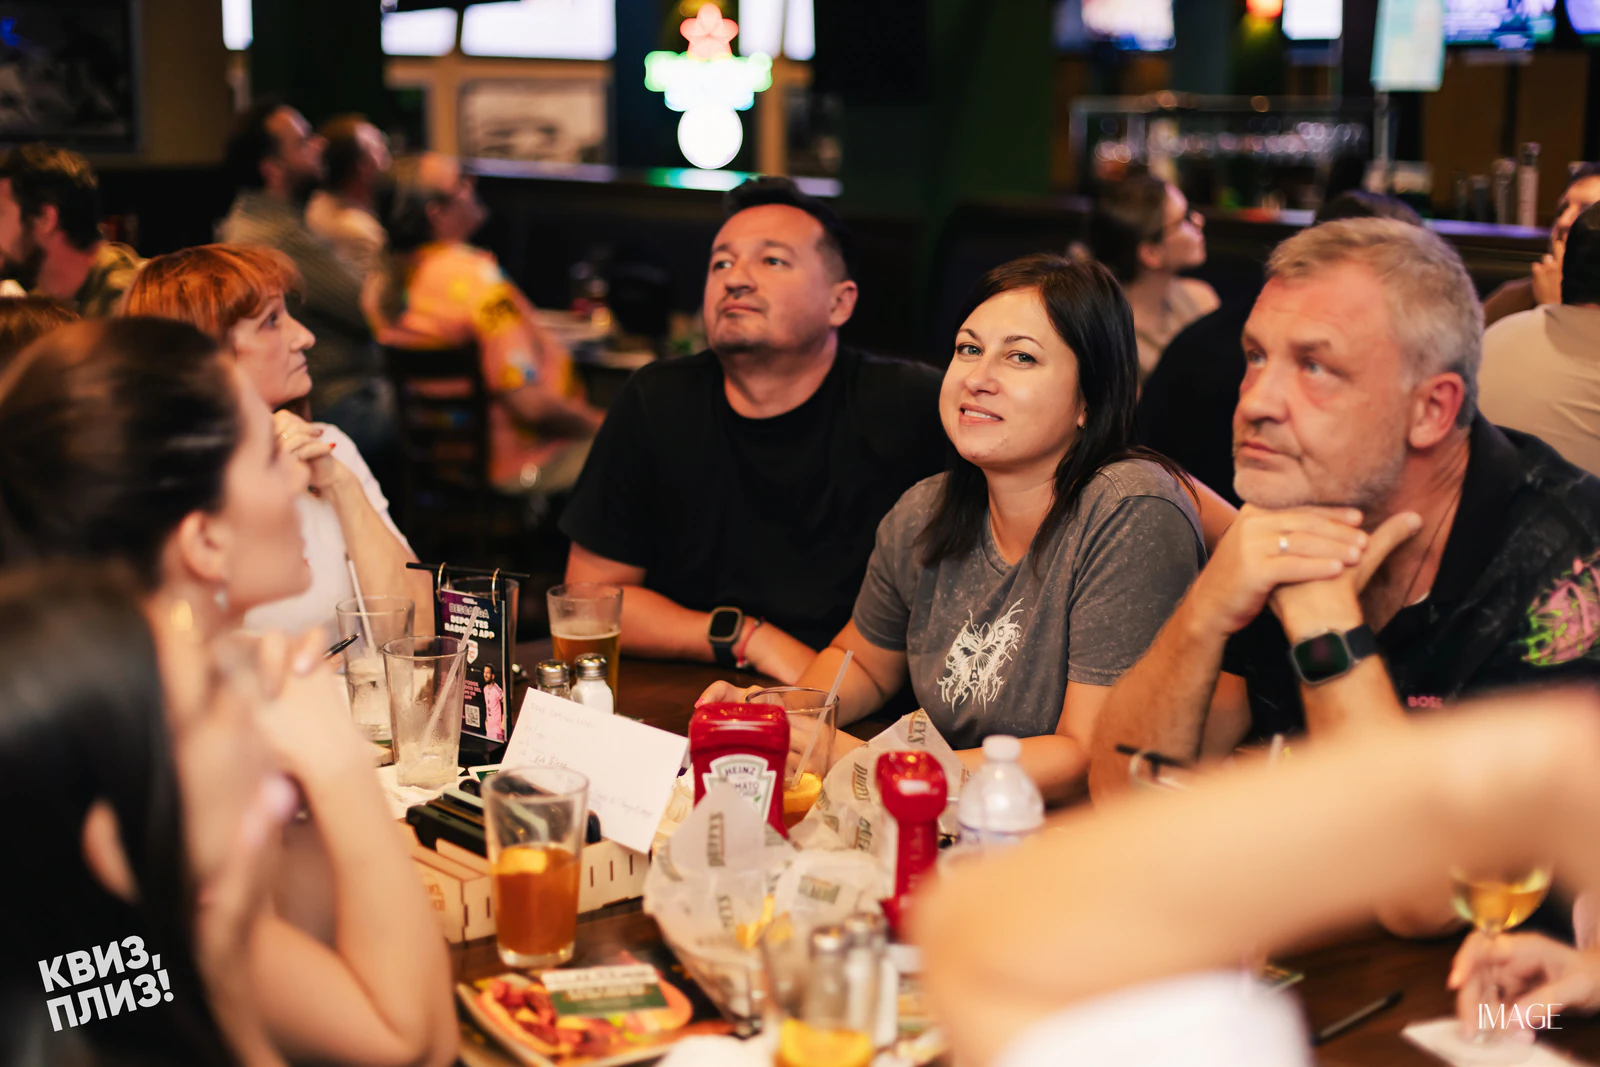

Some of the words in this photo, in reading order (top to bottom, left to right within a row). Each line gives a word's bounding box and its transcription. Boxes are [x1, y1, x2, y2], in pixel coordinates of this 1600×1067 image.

[449, 602, 489, 618] DESCAGA
[450, 615, 489, 629] DEPOTES
[725, 766, 756, 777] HEINZ
[734, 781, 760, 792] MATO
